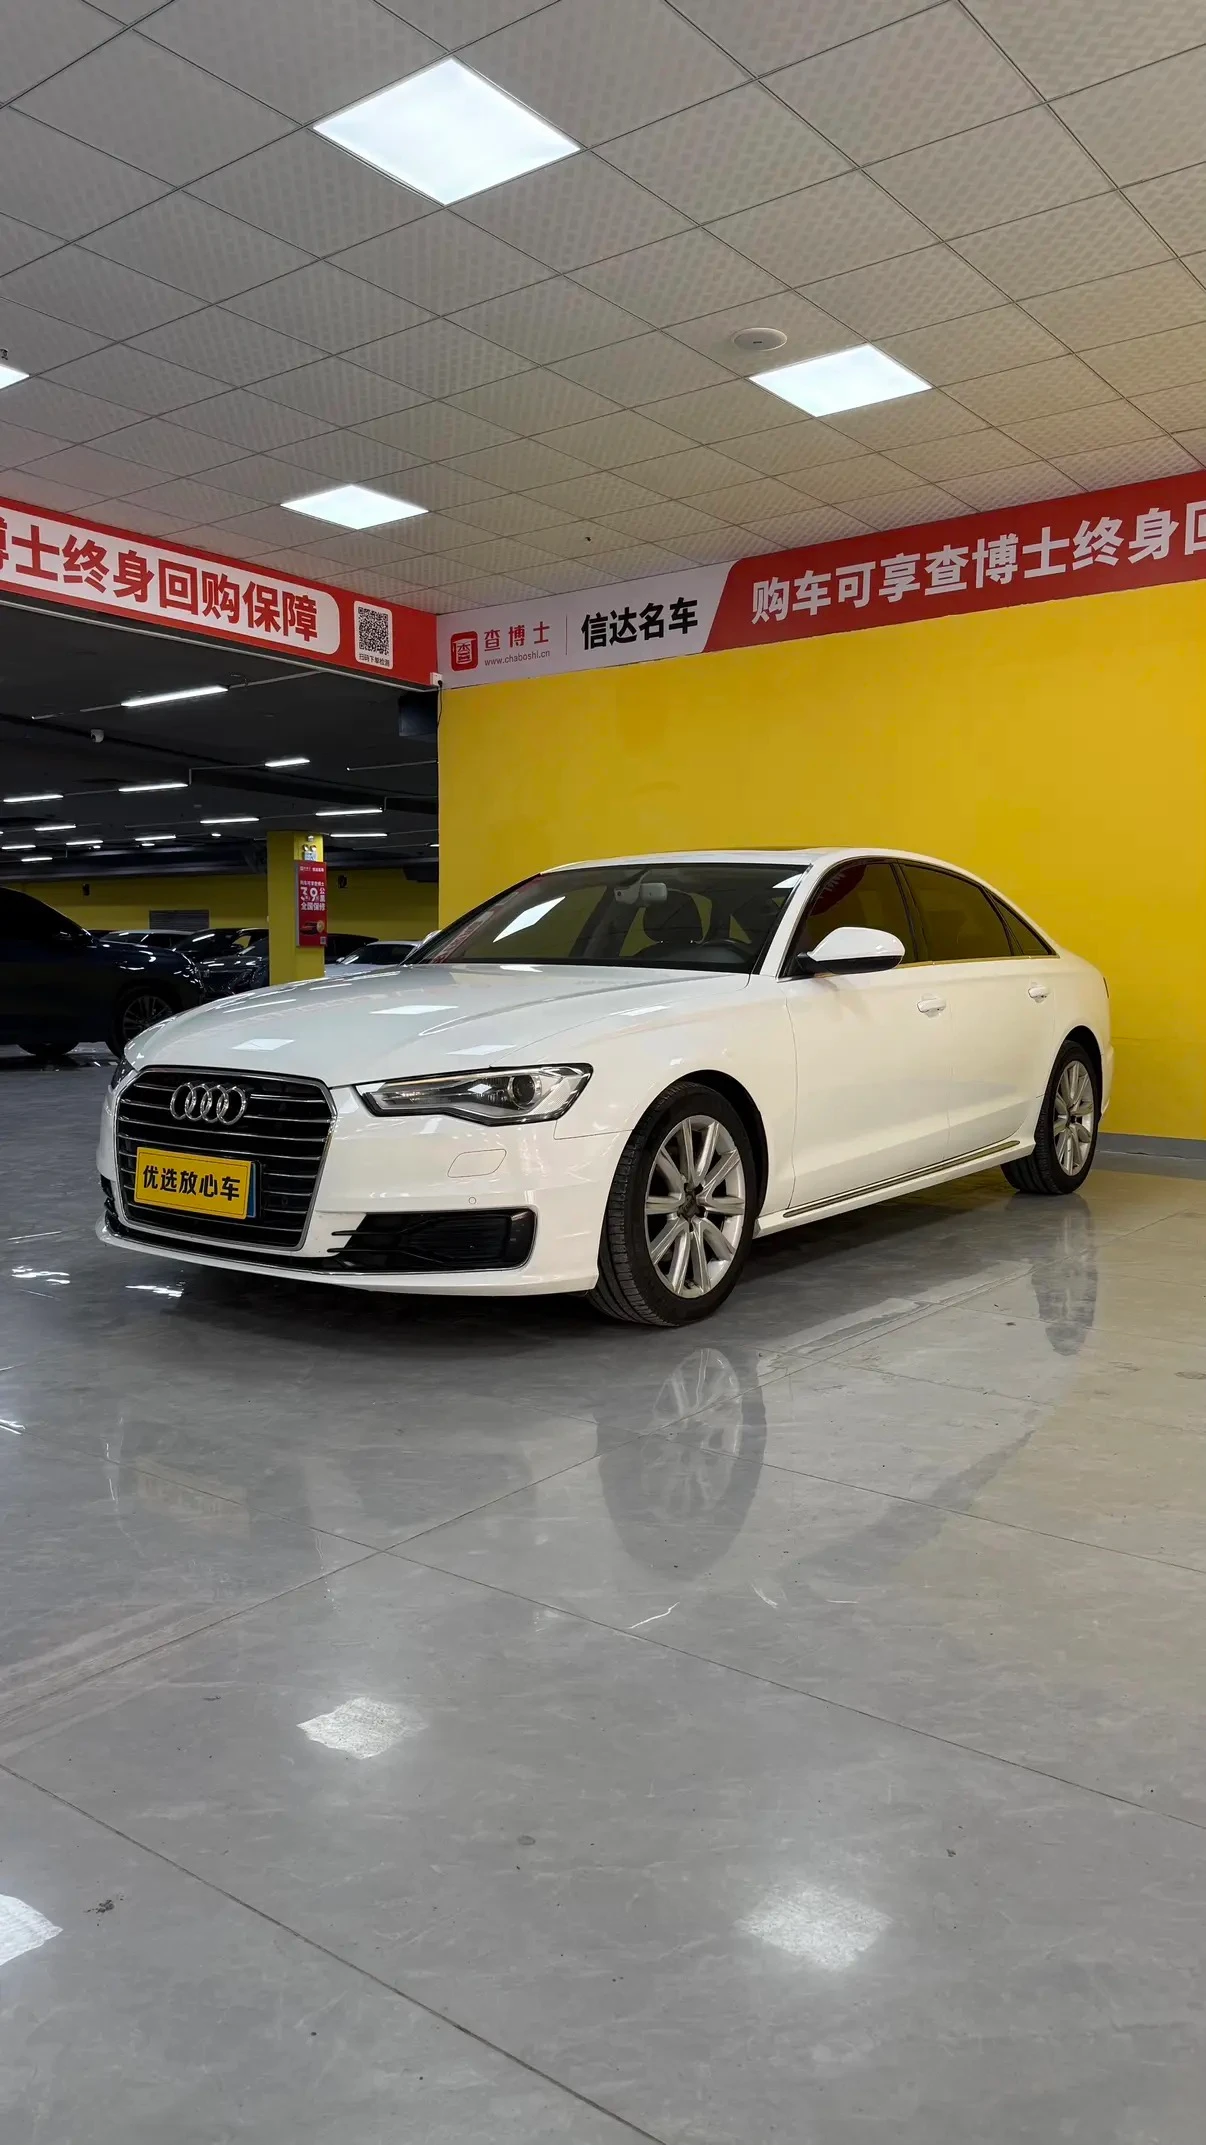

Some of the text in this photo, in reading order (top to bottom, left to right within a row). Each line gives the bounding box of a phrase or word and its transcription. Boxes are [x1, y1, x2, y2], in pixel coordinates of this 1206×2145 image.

[0, 516, 318, 642] 士终身回购保障
[484, 621, 550, 652] 查博士
[581, 597, 698, 650] 信达名车
[484, 650, 550, 666] www.chaboshi.cn
[143, 1165, 240, 1201] 优选放心车
